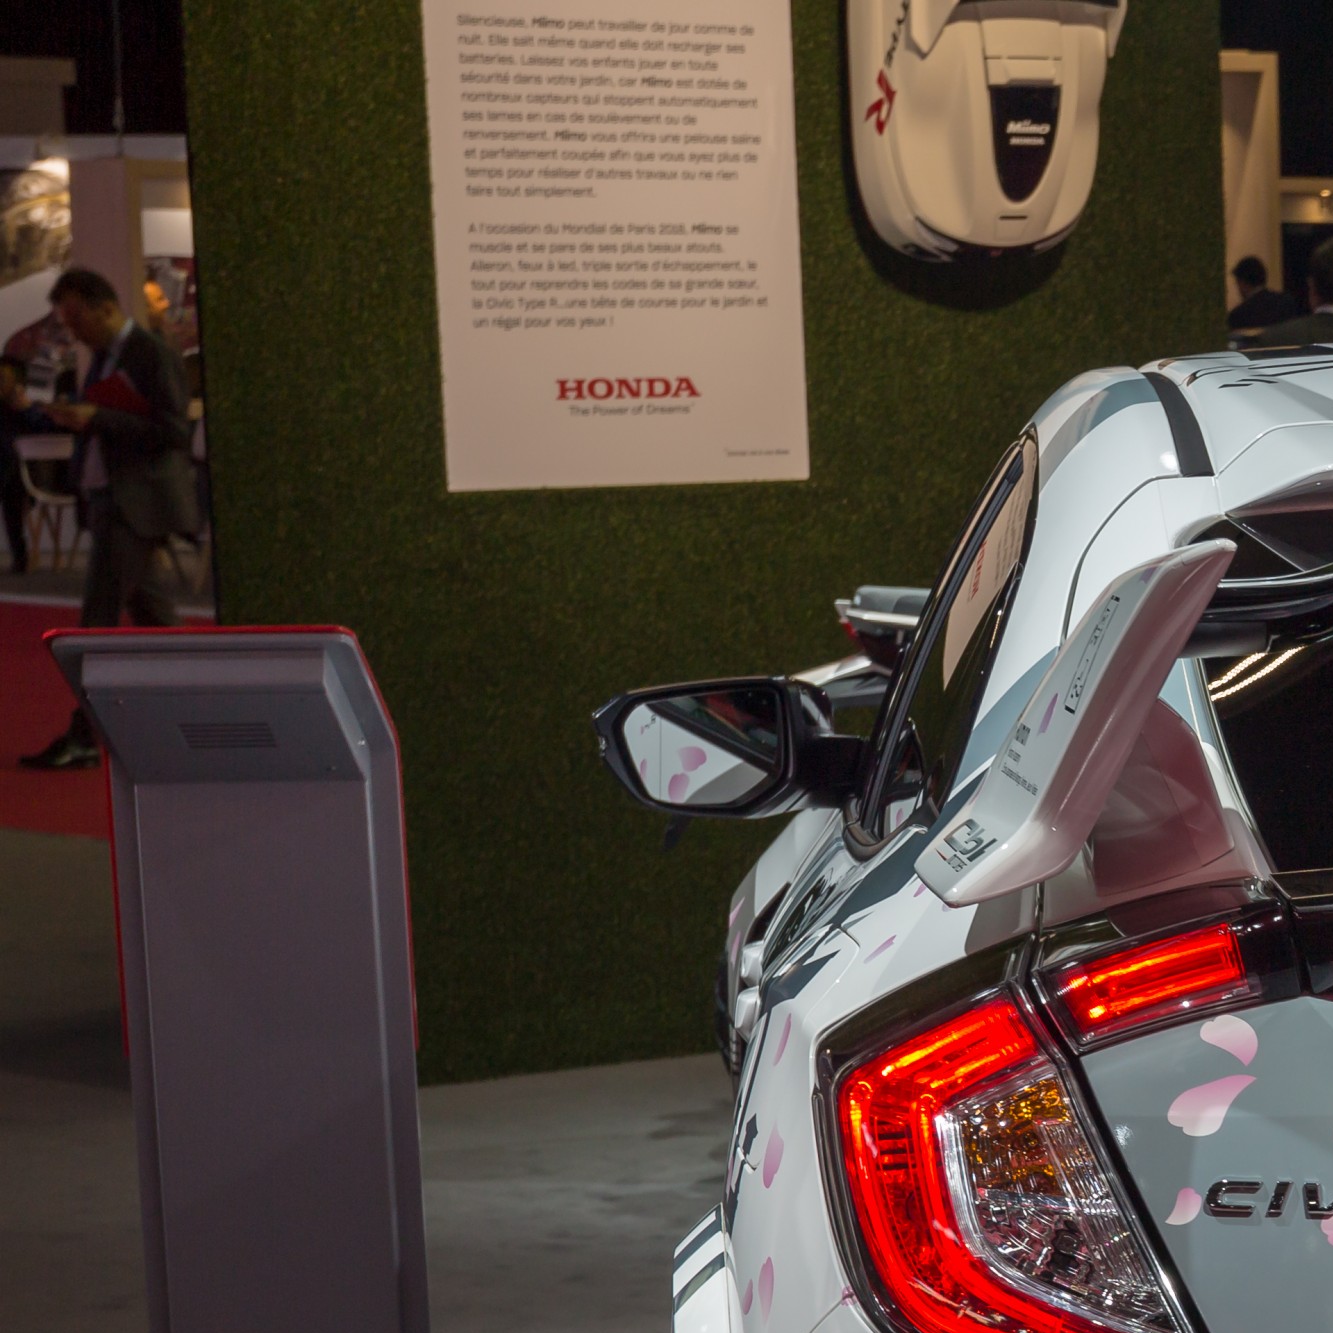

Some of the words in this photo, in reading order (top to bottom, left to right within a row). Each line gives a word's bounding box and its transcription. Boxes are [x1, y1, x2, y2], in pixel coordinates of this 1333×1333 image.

[556, 376, 701, 400] HONDA
[569, 405, 590, 416] The
[592, 405, 628, 415] Power
[630, 404, 643, 415] of
